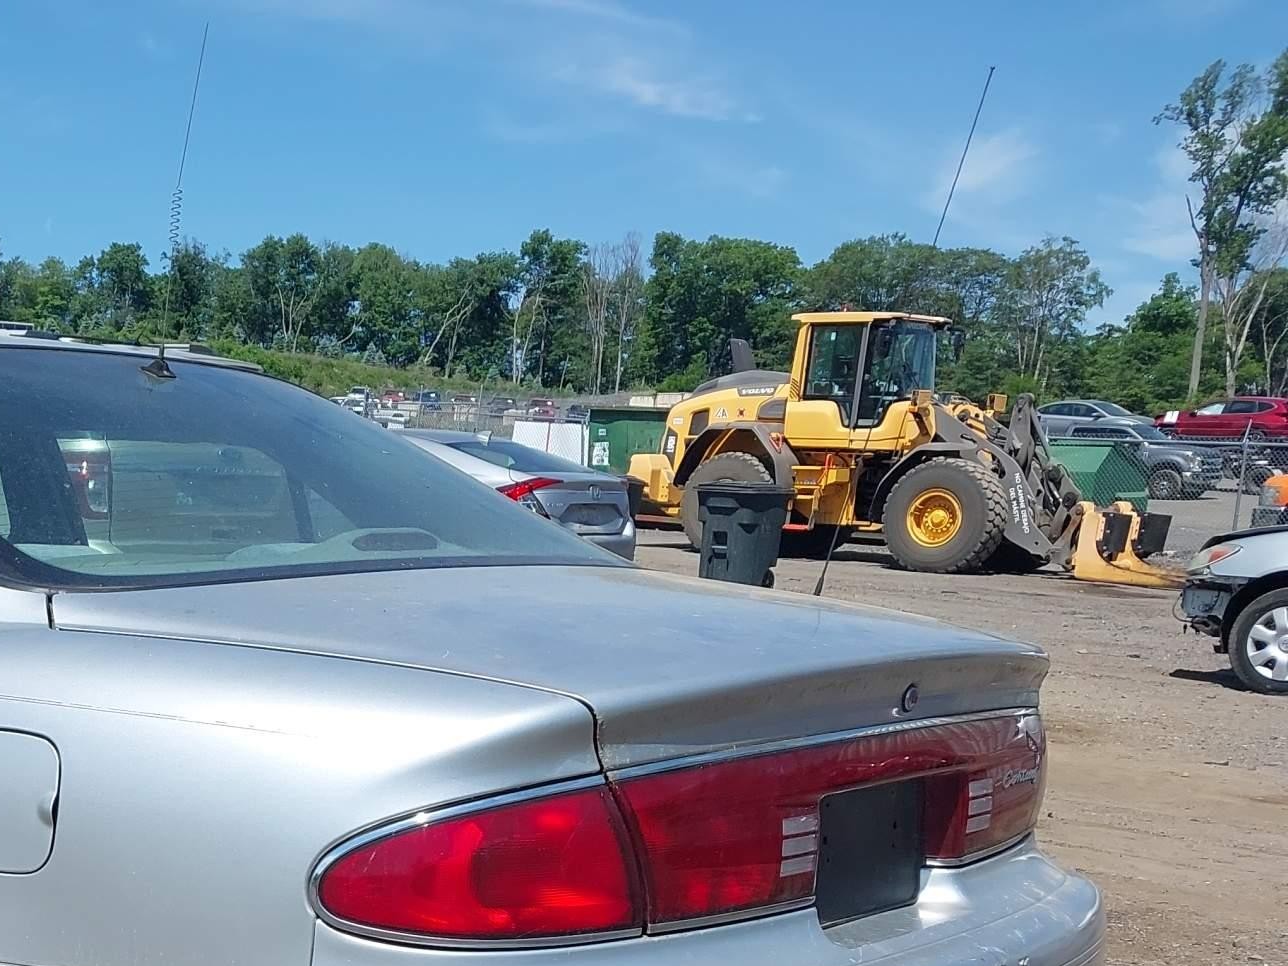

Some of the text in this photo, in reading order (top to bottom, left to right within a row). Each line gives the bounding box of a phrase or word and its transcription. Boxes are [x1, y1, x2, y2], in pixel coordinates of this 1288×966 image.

[742, 387, 774, 395] VOLVO
[1014, 472, 1022, 484] NO
[1021, 509, 1030, 534] DEBAJO
